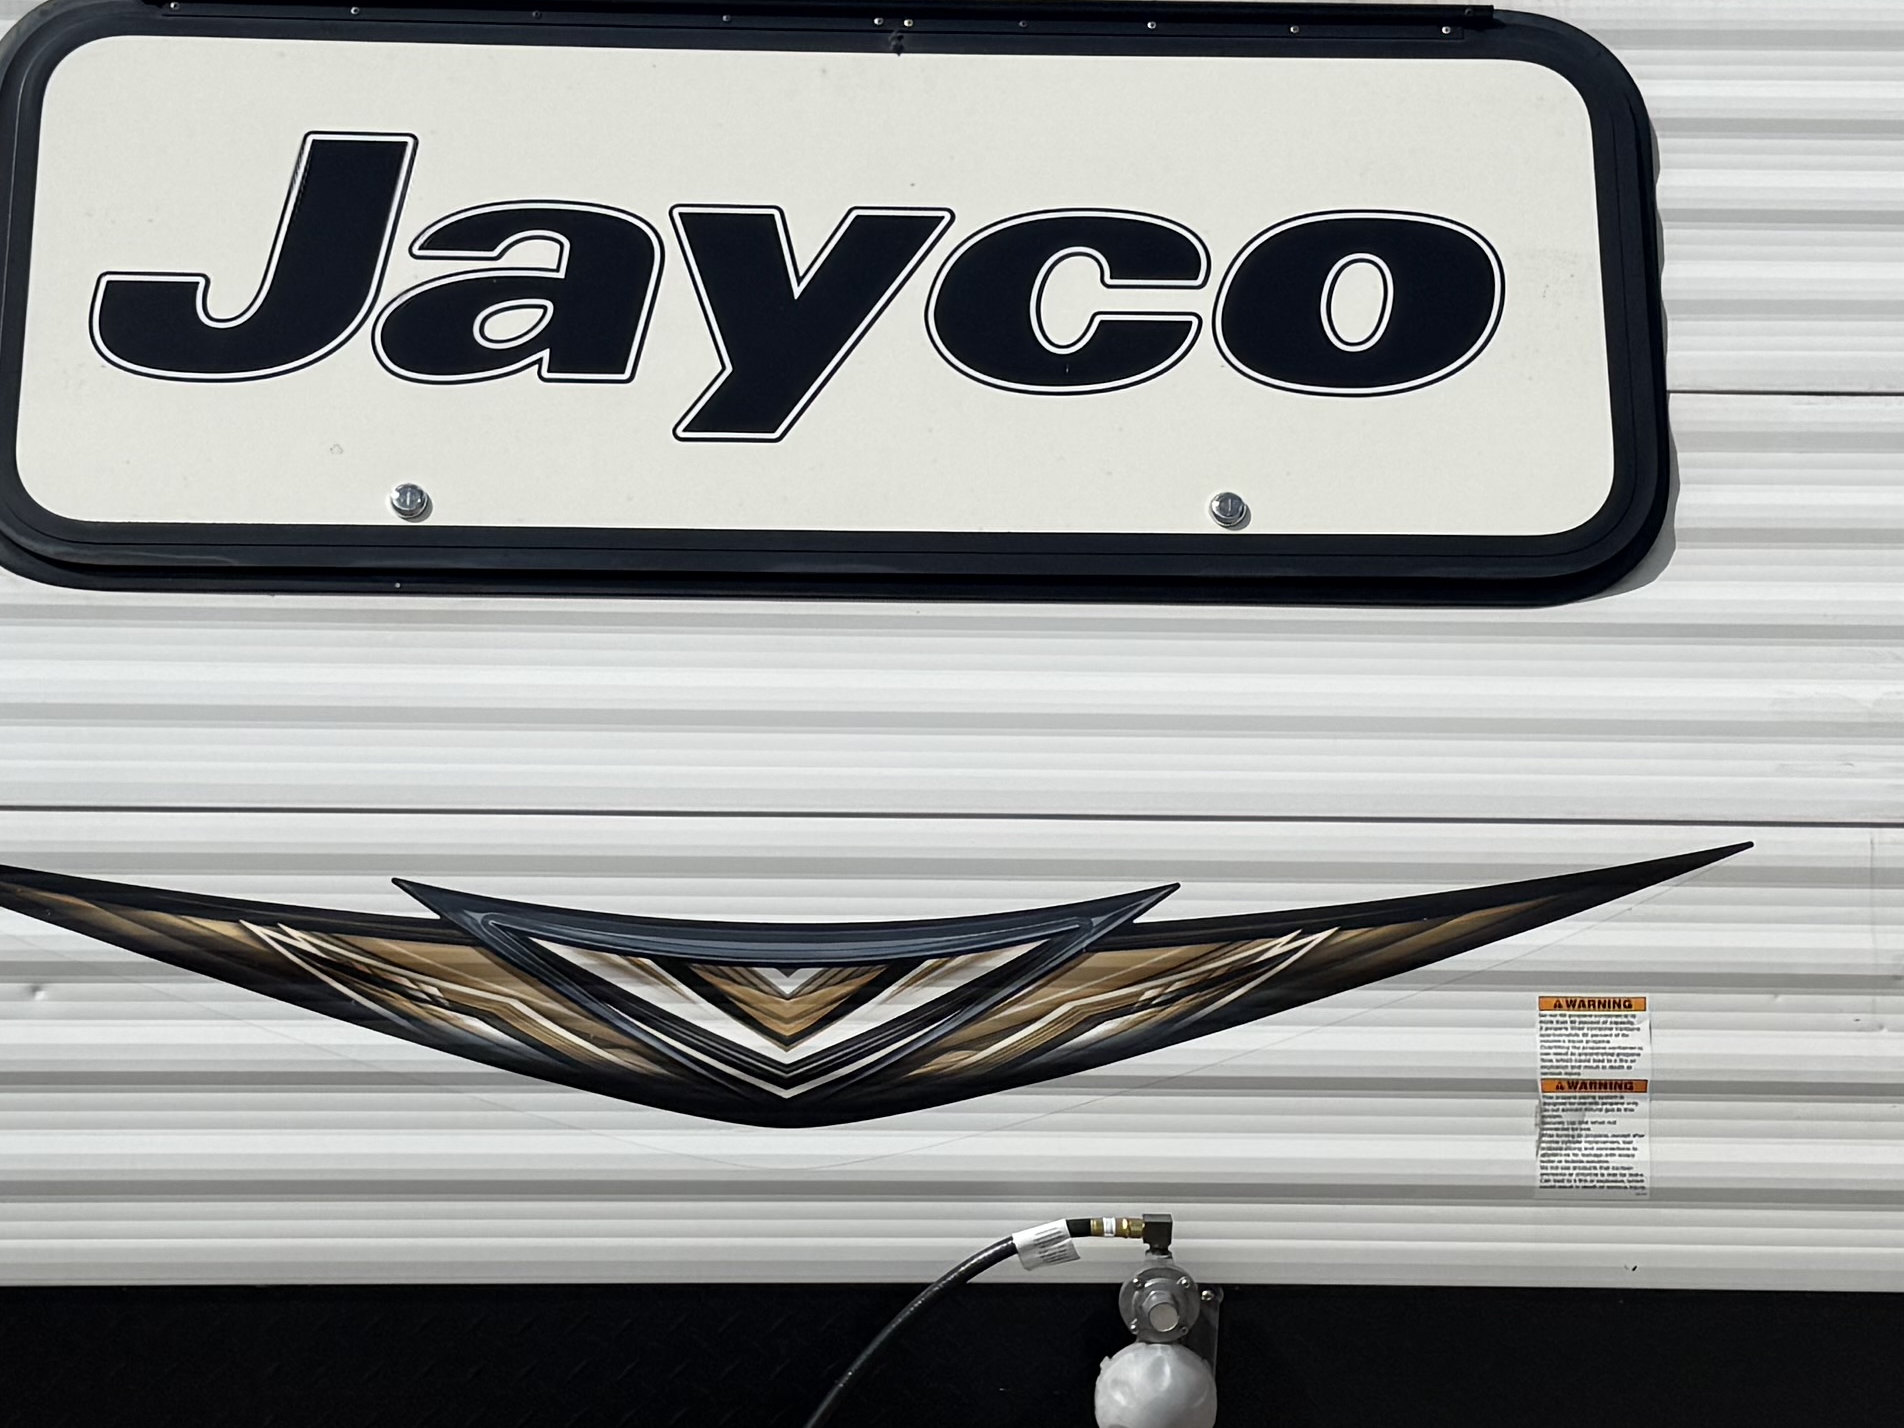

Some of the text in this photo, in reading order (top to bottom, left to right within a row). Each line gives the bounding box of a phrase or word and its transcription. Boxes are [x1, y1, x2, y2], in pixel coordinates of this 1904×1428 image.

[87, 129, 1505, 445] Jayco
[1565, 999, 1633, 1009] WARNING
[1566, 1081, 1634, 1091] WARNING
